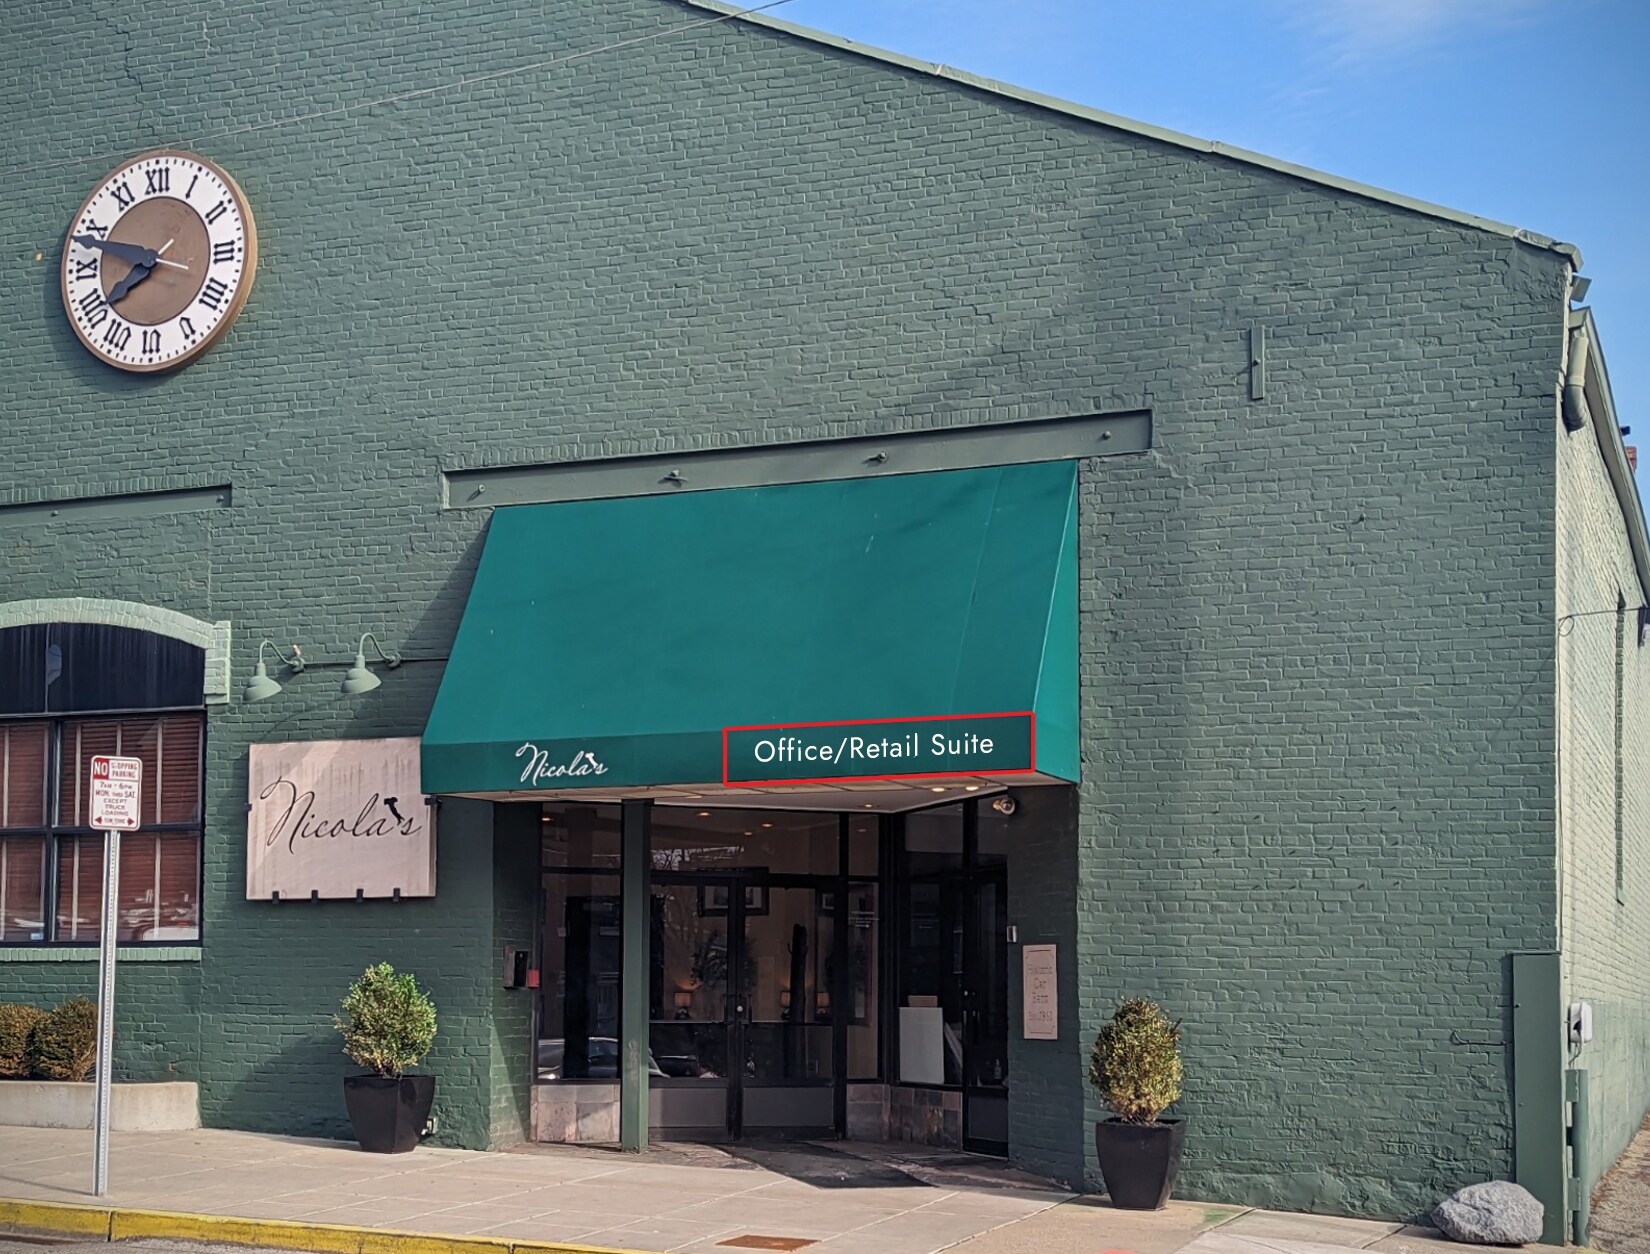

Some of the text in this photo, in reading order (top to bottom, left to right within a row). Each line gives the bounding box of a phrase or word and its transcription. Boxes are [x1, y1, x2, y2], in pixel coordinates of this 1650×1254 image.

[144, 167, 170, 195] XII
[111, 181, 135, 212] XI
[205, 200, 227, 225] II
[213, 239, 236, 264] III
[75, 257, 98, 281] IX
[94, 761, 108, 776] NO
[111, 763, 138, 771] STOPPING
[112, 770, 136, 778] PARKING
[515, 742, 609, 787] Nicola's
[260, 775, 422, 855] Nicola's
